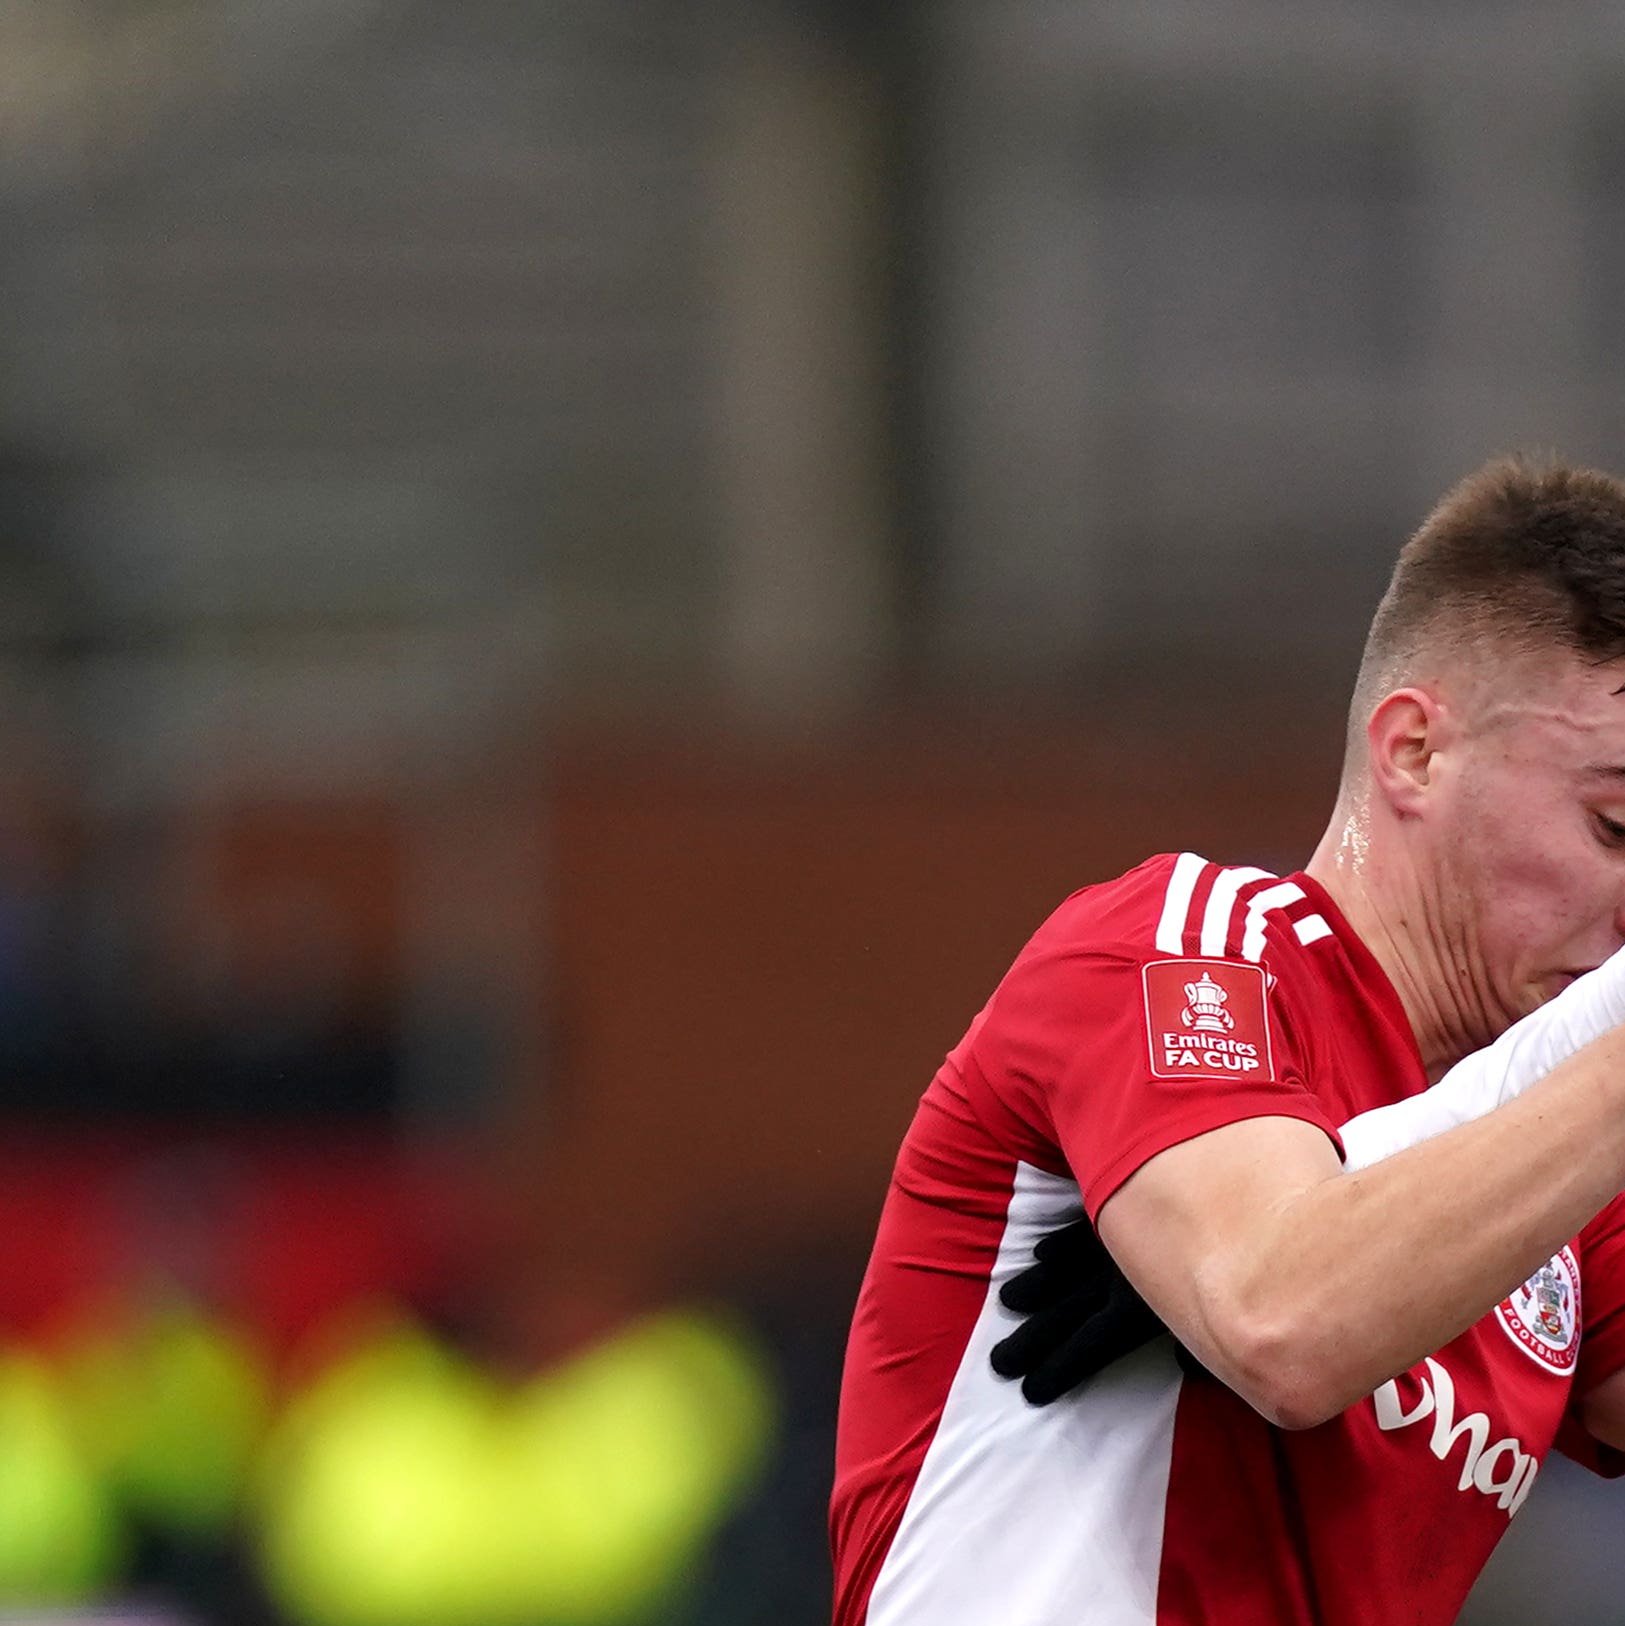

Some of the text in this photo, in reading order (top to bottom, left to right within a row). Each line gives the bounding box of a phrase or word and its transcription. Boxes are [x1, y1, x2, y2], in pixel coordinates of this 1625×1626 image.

[1163, 1032, 1258, 1056] Emirates
[1165, 1050, 1259, 1072] FA CUP
